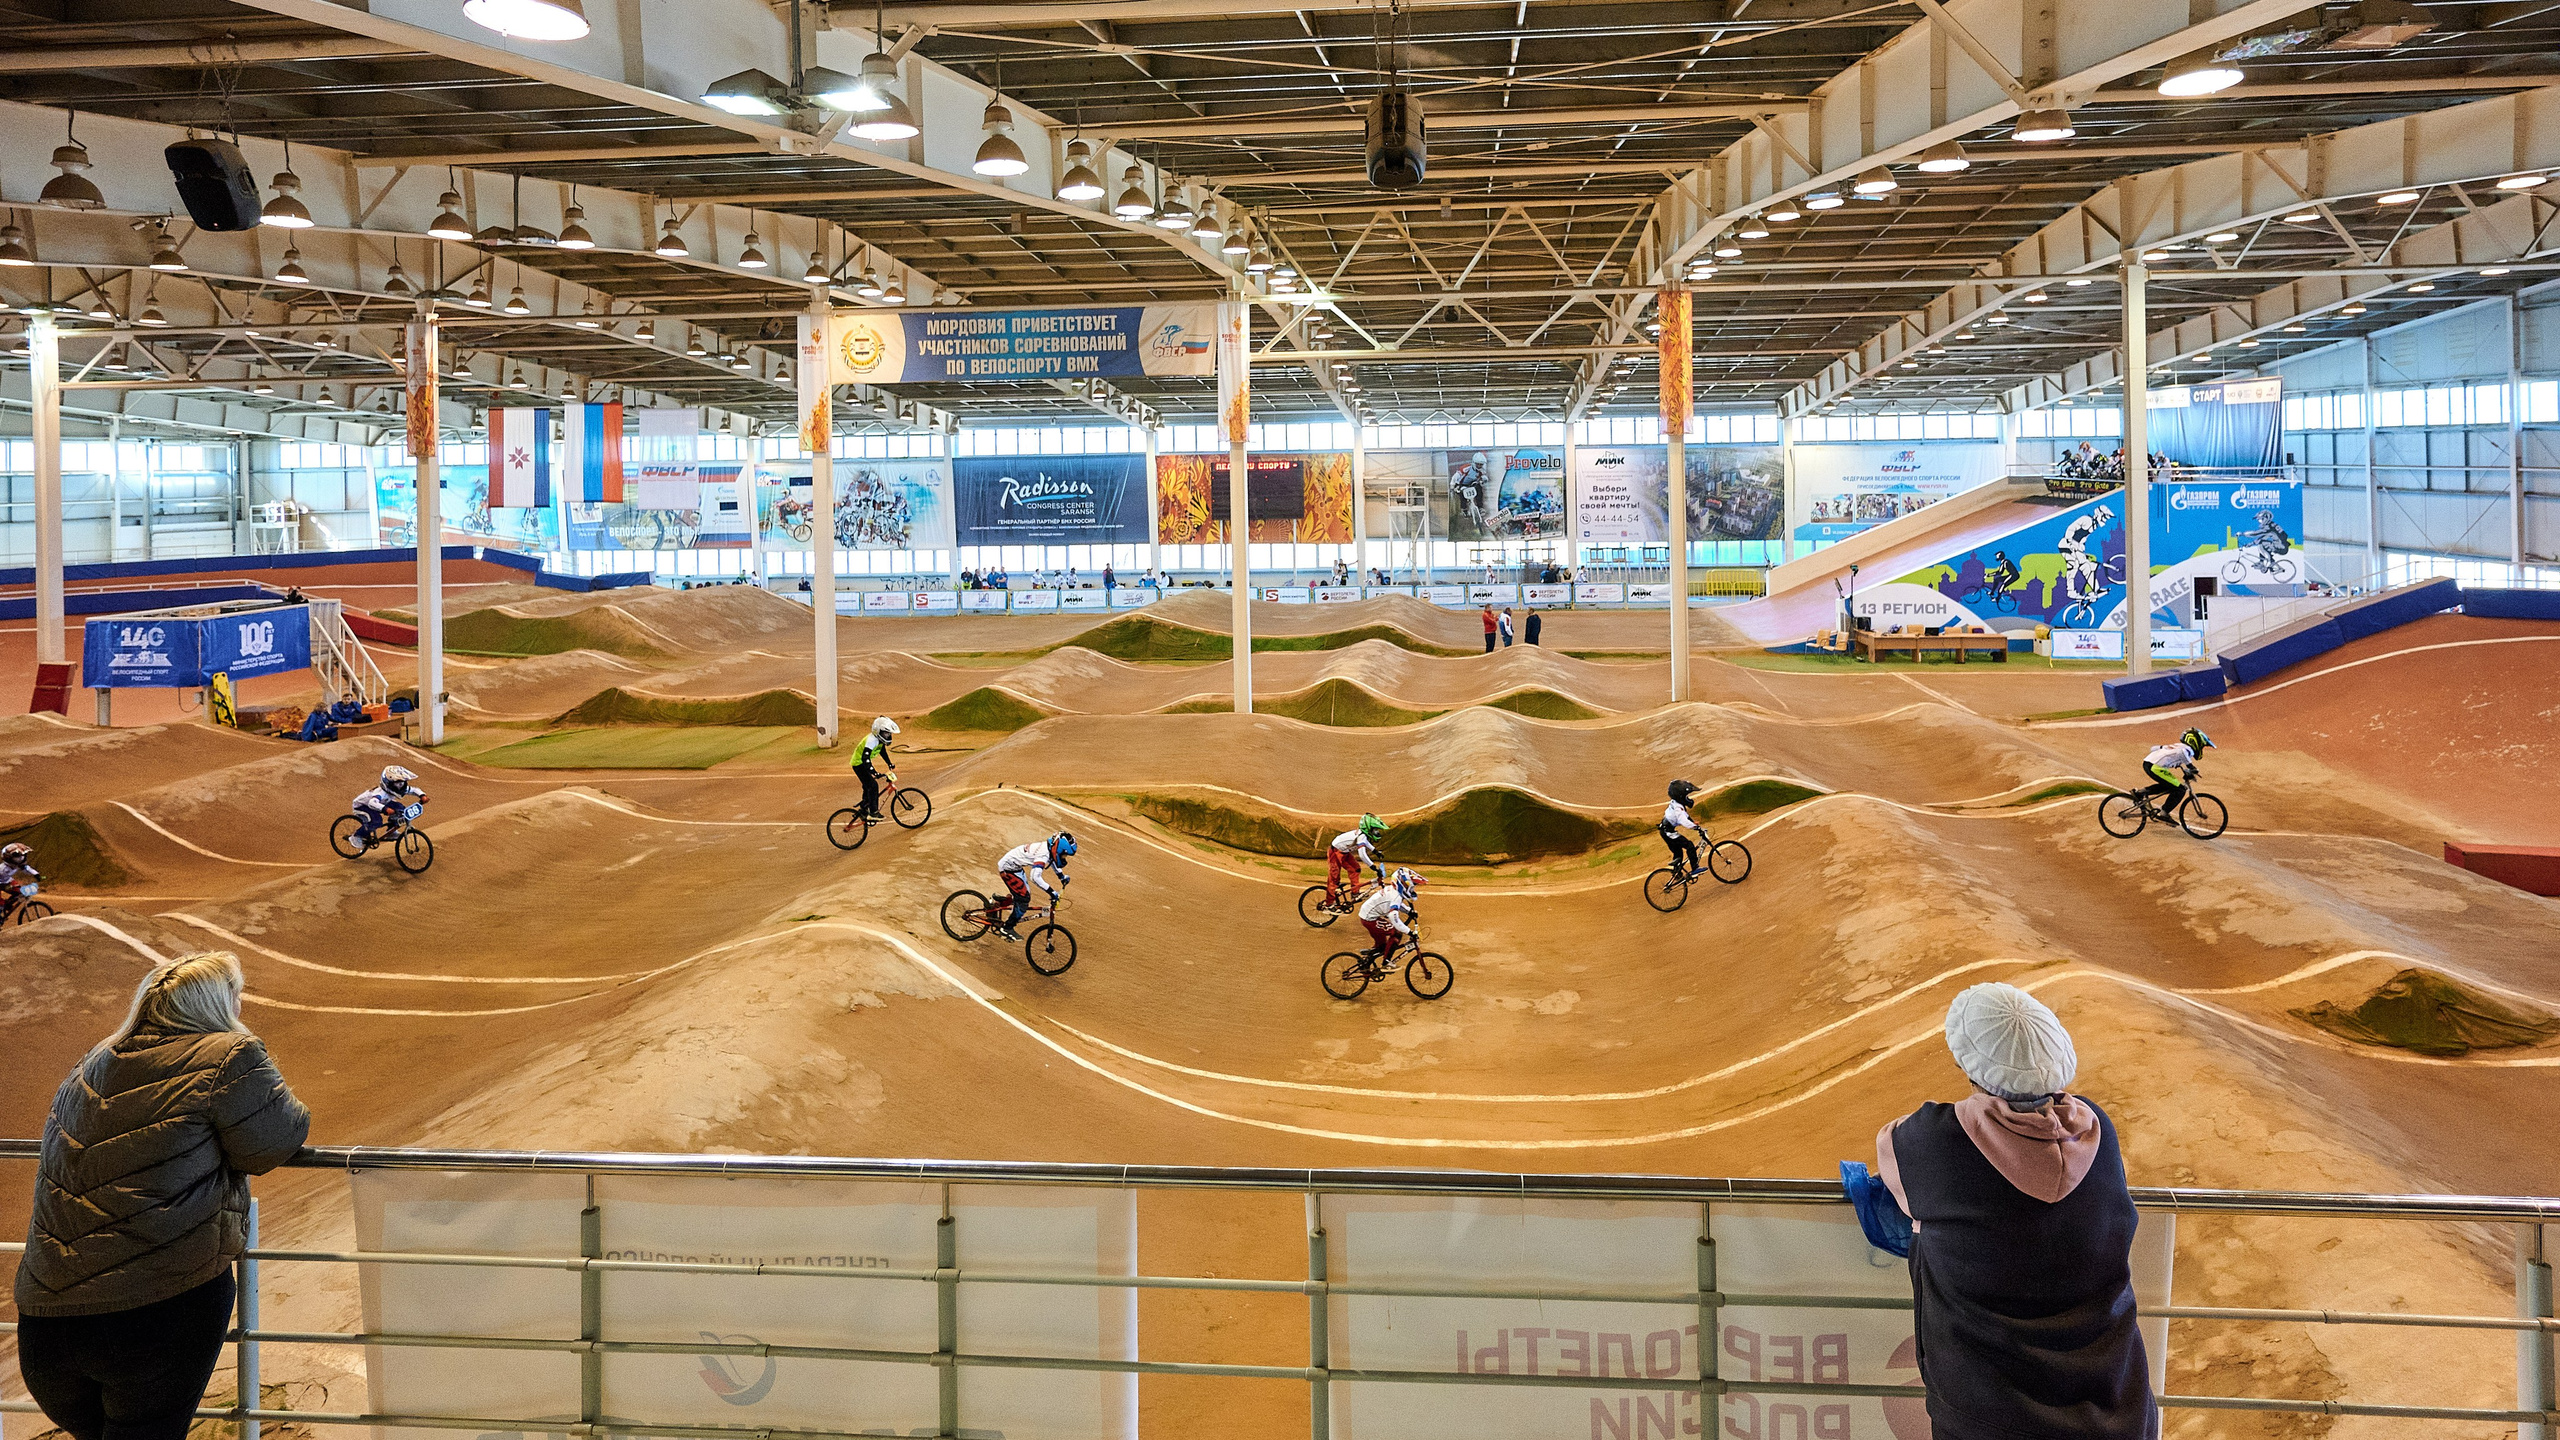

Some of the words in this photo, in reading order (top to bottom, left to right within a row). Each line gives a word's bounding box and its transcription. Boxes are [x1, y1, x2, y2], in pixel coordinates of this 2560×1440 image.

[926, 318, 1006, 336] МОРДОВИЯ
[1011, 315, 1118, 333] ПРИВЕТСТВУЕТ
[918, 338, 1009, 356] УЧАСТНИКОВ
[1014, 332, 1127, 353] СОРЕВНОВАНИЙ
[946, 359, 966, 375] ПО
[971, 357, 1062, 375] ВЕЛОСПОРТУ
[2193, 389, 2222, 402] СТАРТ
[1257, 461, 1291, 470] СПОРТУ
[1504, 454, 1562, 470] Provelo
[1595, 457, 1625, 466] МИК
[999, 472, 1094, 509] Radisson
[1592, 485, 1627, 493] Выбери
[2246, 490, 2280, 499] ГАЗПРОМ
[1589, 494, 1631, 502] квартиру
[2187, 491, 2220, 500] ГАЗПРОМ
[1594, 514, 1640, 523] 44-44-54
[609, 526, 656, 537] ВЕЛОСПОРТ
[664, 526, 680, 536] ЭТО
[2150, 577, 2190, 607] RACE
[1860, 603, 1876, 614] 13
[1883, 603, 1947, 614] РЕГИОН
